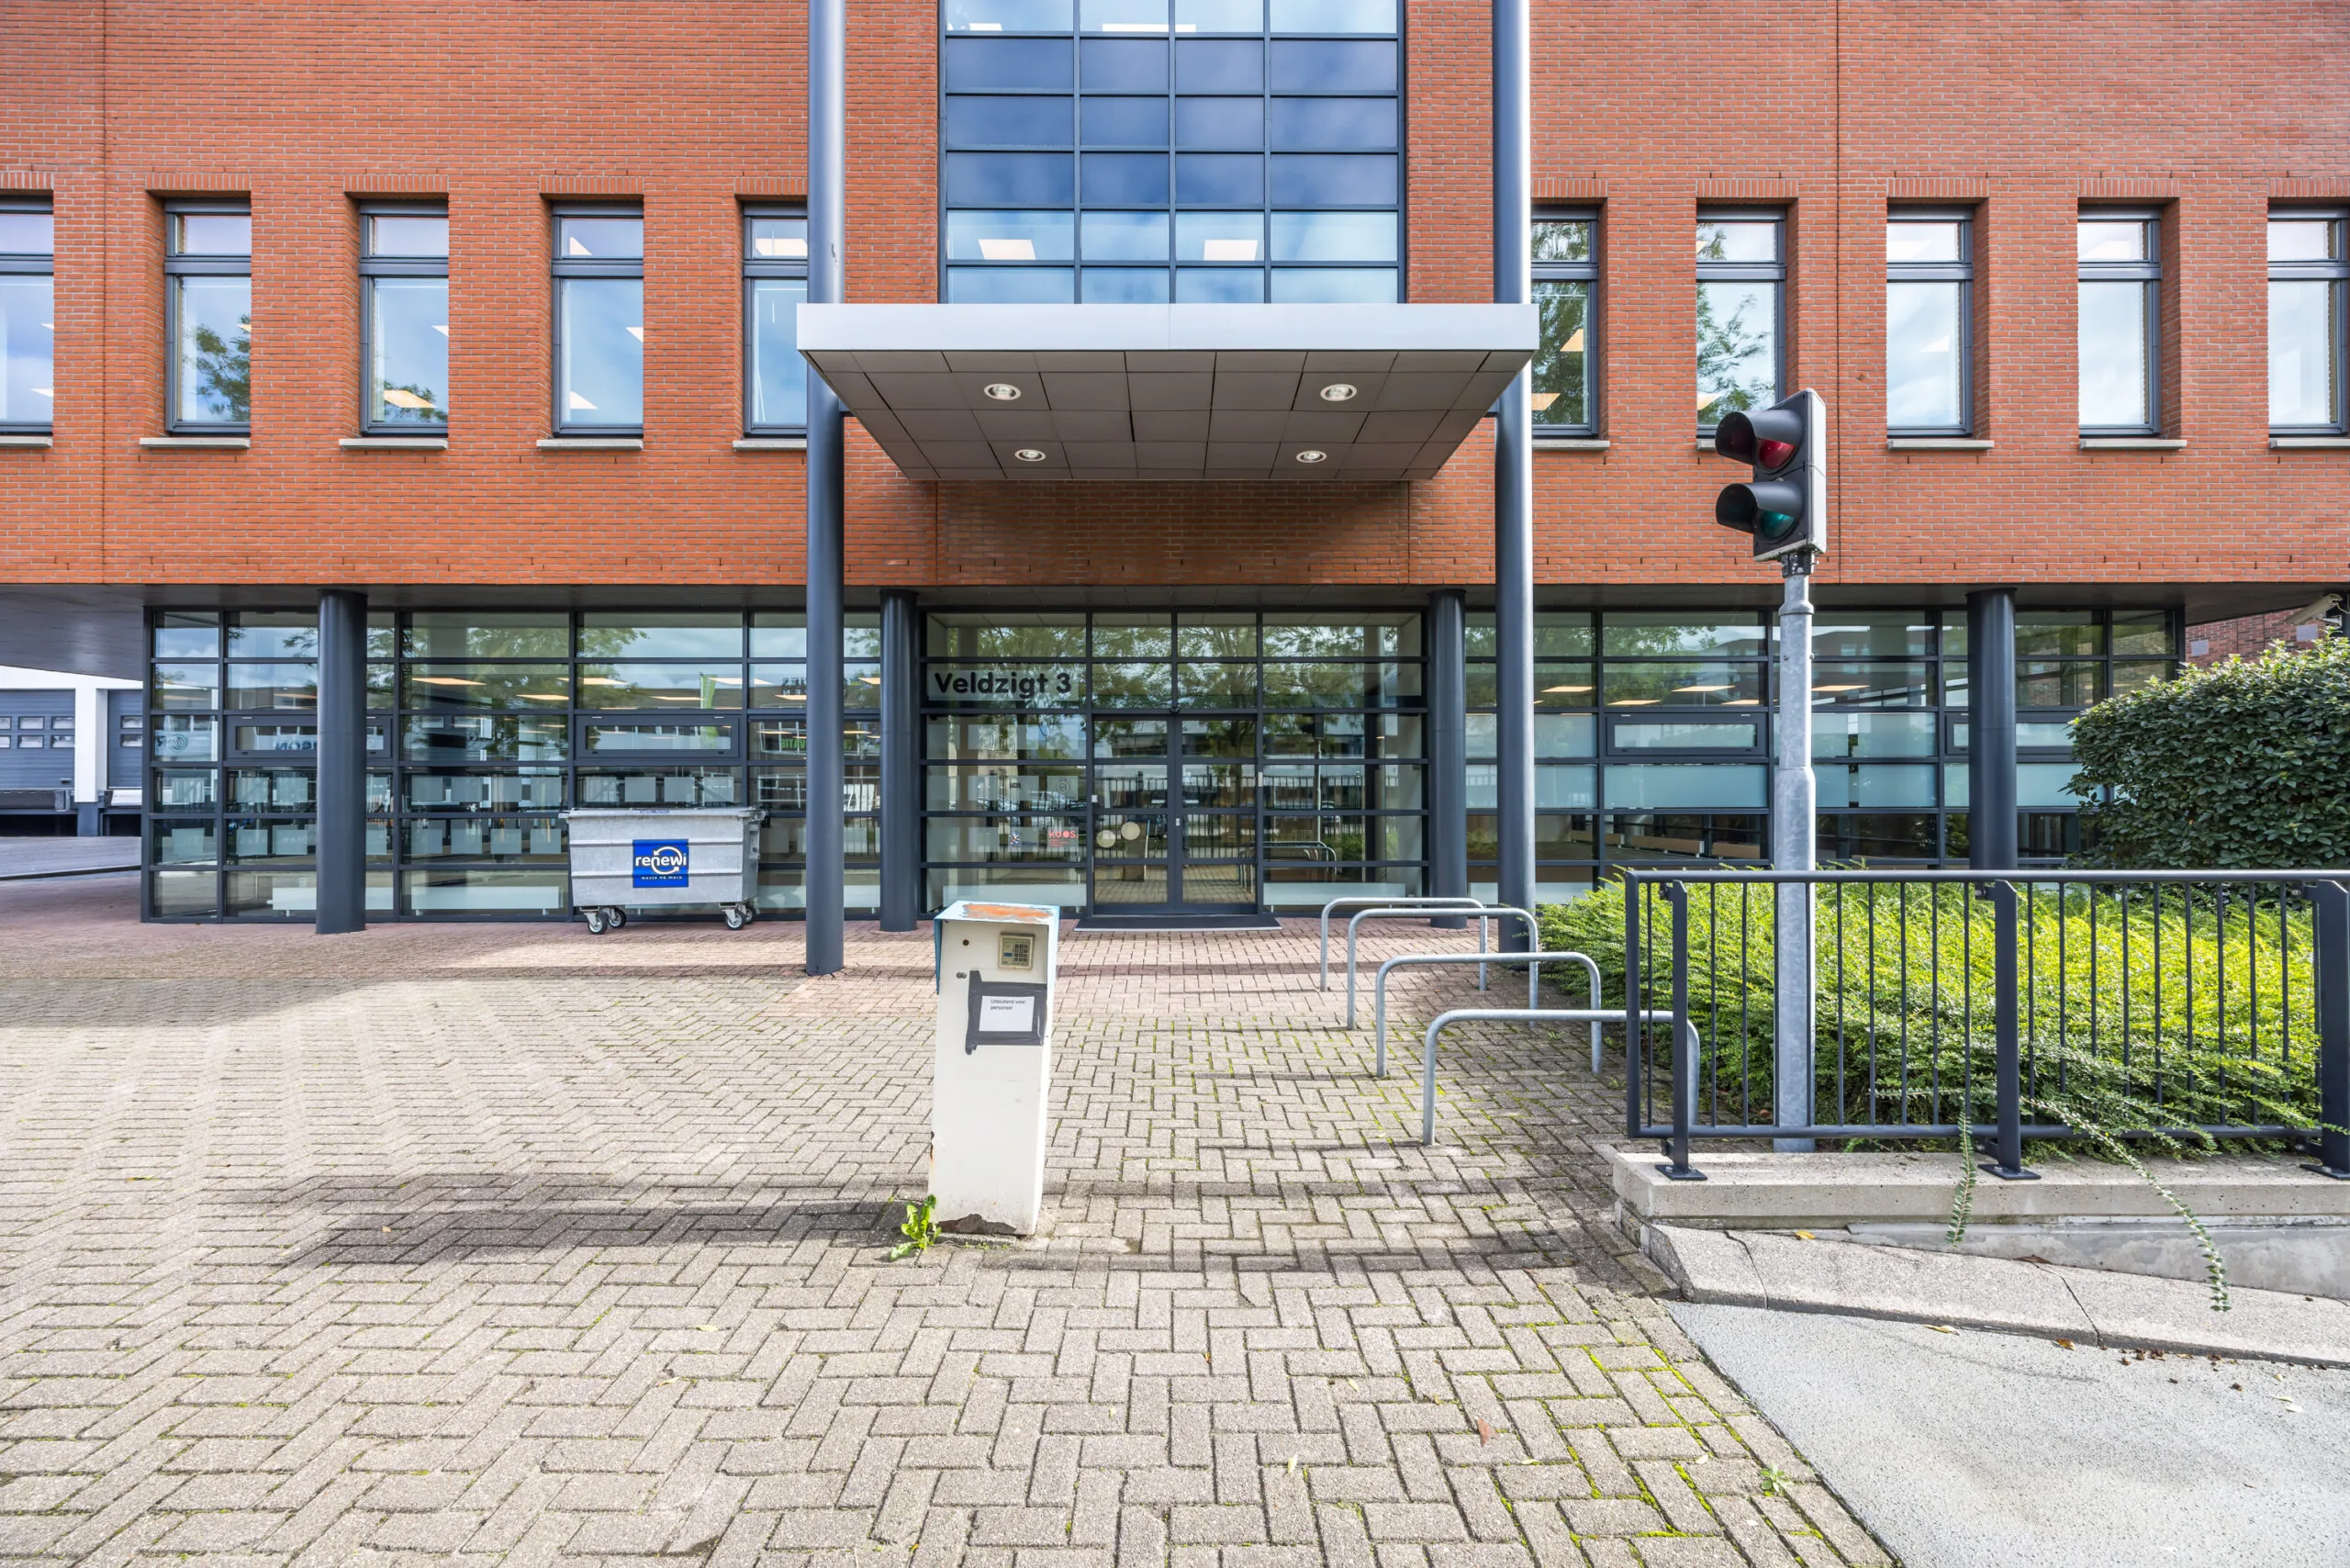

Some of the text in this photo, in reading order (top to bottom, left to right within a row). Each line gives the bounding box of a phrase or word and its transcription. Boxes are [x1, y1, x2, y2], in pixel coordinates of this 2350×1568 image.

[934, 672, 1071, 699] Veldzigt 3
[635, 852, 687, 868] renewi
